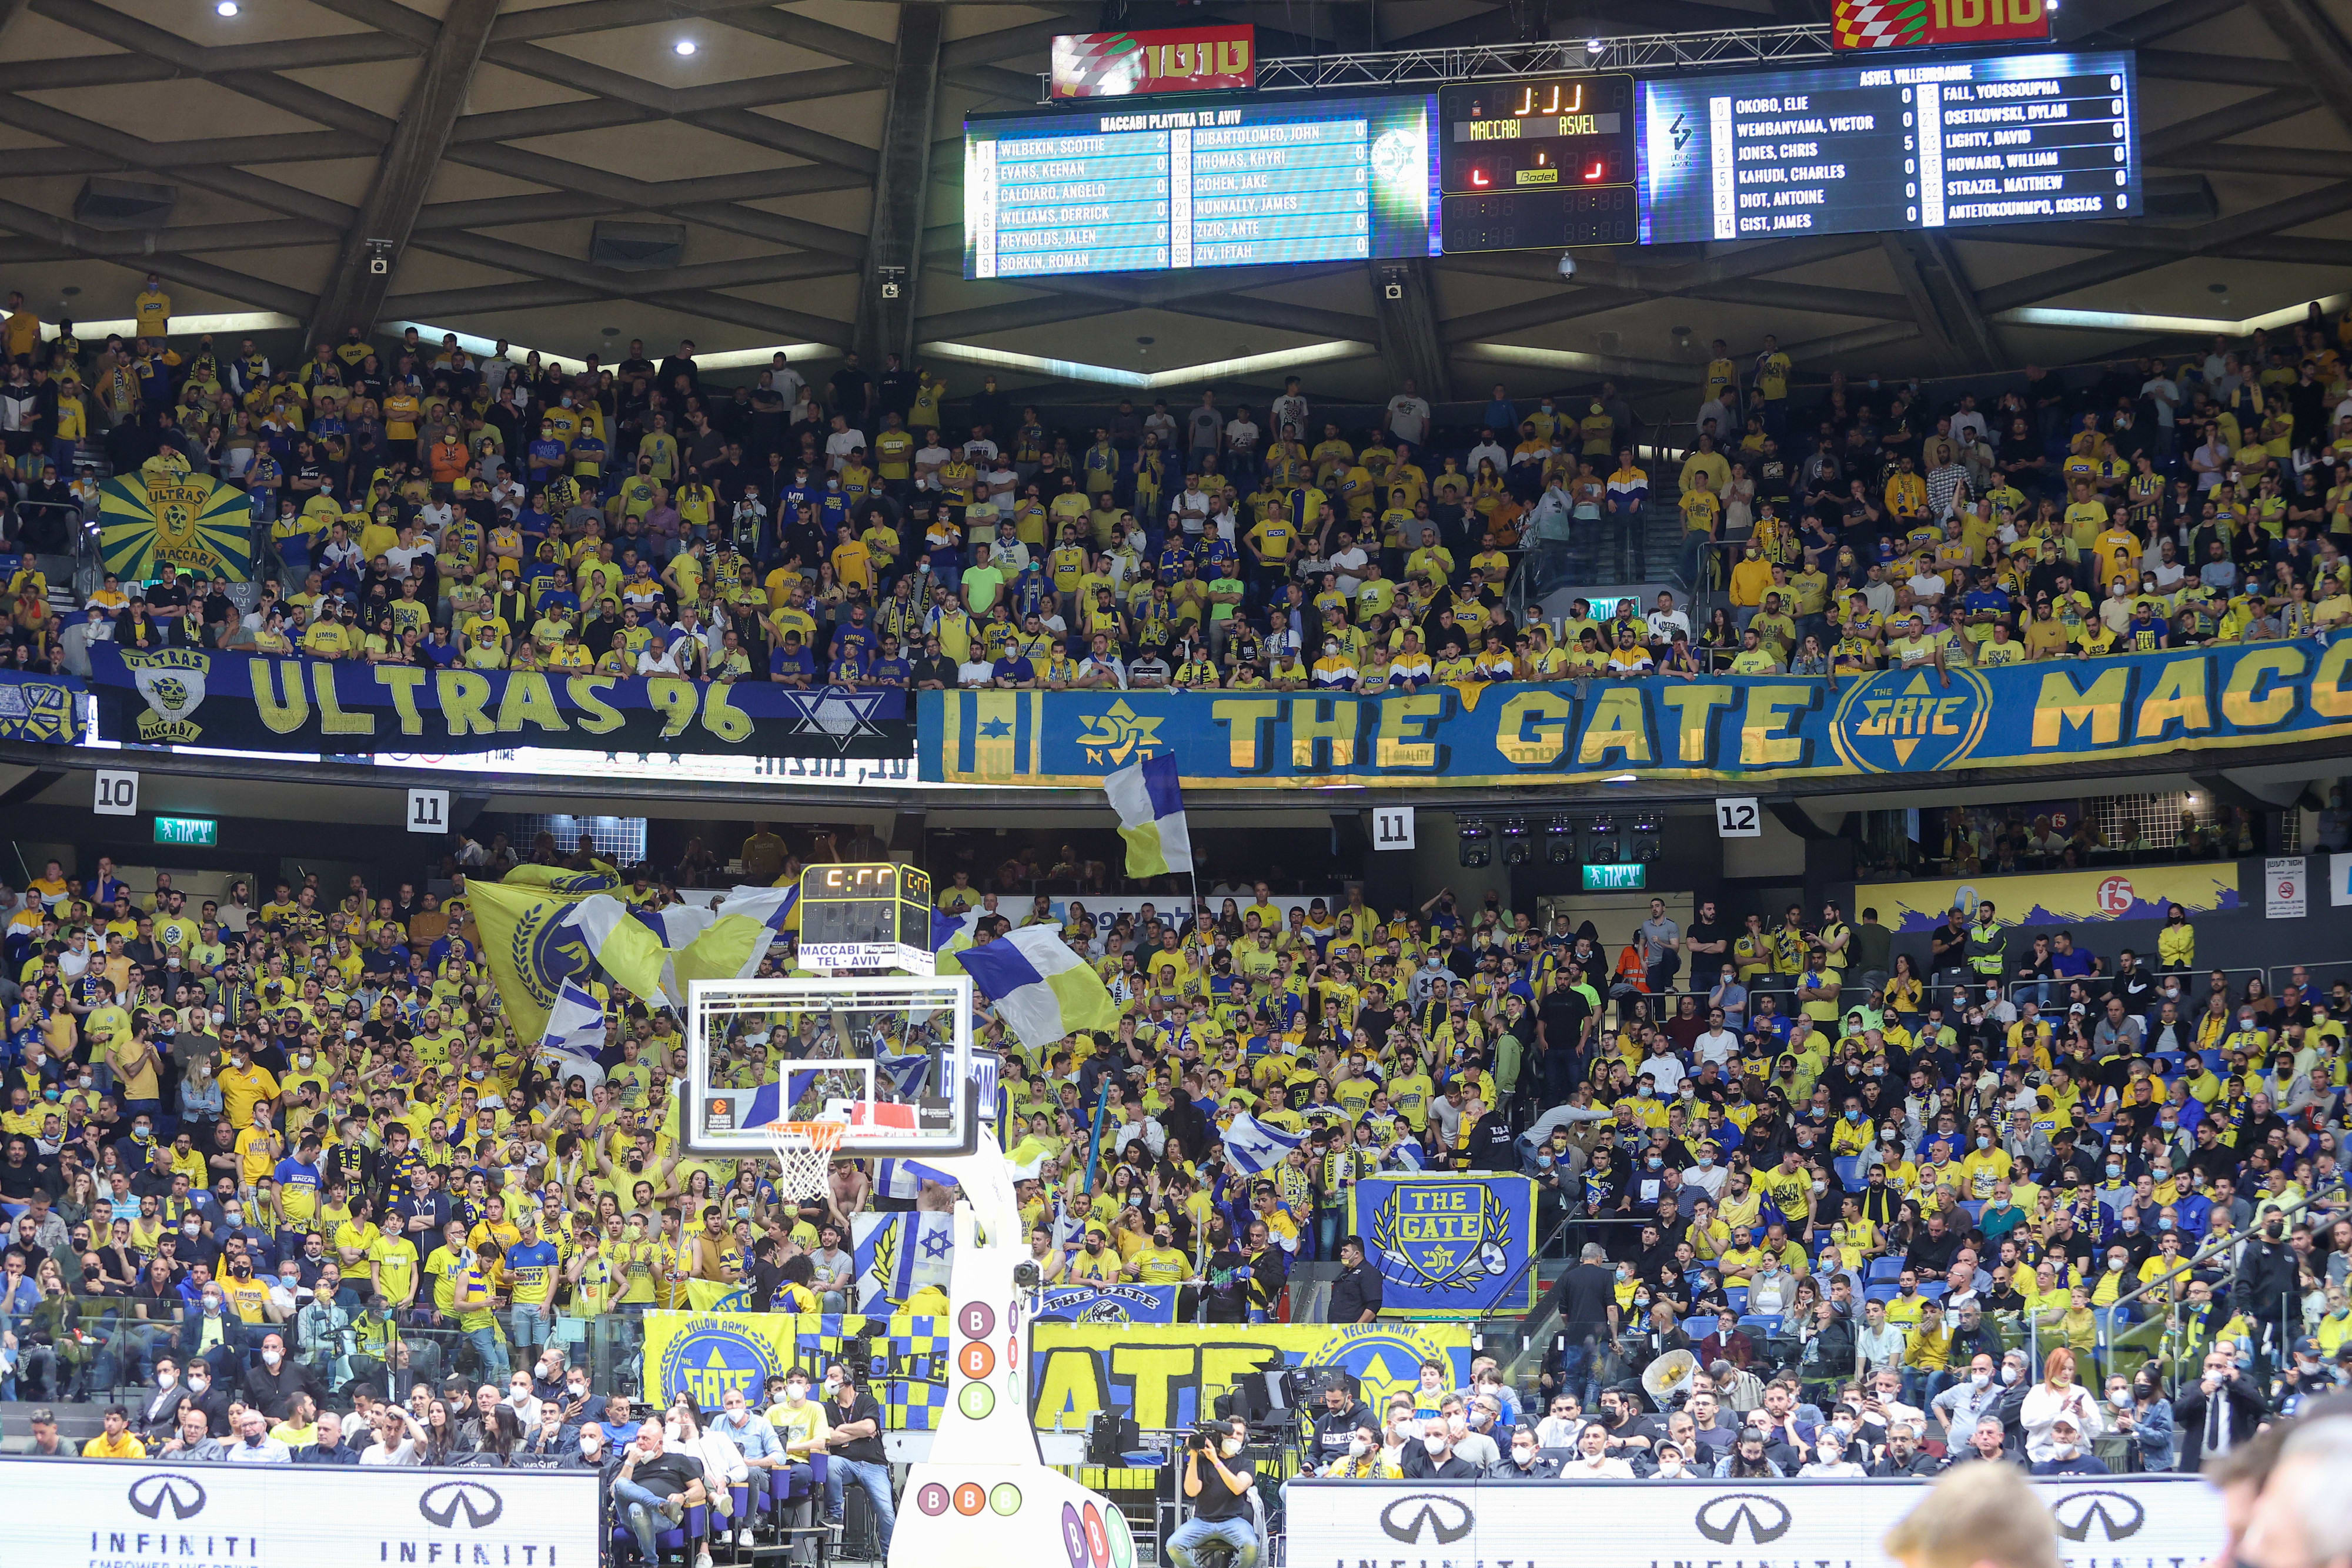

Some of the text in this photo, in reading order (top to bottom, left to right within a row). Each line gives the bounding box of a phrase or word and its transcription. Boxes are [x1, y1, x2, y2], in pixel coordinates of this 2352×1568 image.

[1859, 65, 1973, 87] ASVEL VILLEURBANNE
[1943, 86, 1975, 101] FALL,
[1976, 81, 2060, 99] YOUSSOUPHA
[2110, 75, 2121, 91] 0
[1736, 98, 1782, 114] OKOBO,
[1785, 96, 1809, 111] ELIE
[1902, 88, 1912, 103] 0
[1945, 98, 2122, 125] OSETKOWSKI, DYLAN 0
[1101, 110, 1241, 132] MACCABI PLAYTIKA TEL AVIV
[1470, 115, 1599, 141] MACCABI ASVEL
[1736, 112, 1912, 138] WEMBANYAMA, VICTOR 0
[1176, 126, 1319, 148] 12 DIBARTOLOMEO, JOHN
[1945, 122, 2123, 148] LIGHTY, DAVID 0
[984, 133, 1165, 159] 1 WILBEKIN, SCOTTIE 2
[1738, 135, 1913, 161] JONES, CHRIS 5
[1176, 152, 1285, 170] 13 THOMAS, KHYRI
[1946, 146, 2124, 172] HOWARD, WILLIAM 0
[983, 162, 1084, 182] 2 EVANS, KEENAN
[1519, 172, 1555, 182] Bodet
[1739, 159, 1914, 184] KAHUDI, CHARLES 0
[1176, 175, 1267, 193] 15 COHEN, JAKE
[1947, 170, 2126, 196] STRAZEL, MATTHEW 0
[983, 183, 1105, 205] 4 CALOIARO, ANGELO
[1739, 183, 1915, 208] DIOT, ANTOINE 0
[2056, 196, 2102, 212] KOSTAS
[2116, 193, 2127, 209] 0
[983, 207, 1109, 227] 6 WILLIAMS, DERRICK
[1175, 196, 1297, 217] 21 NUNNALLY, JAMES
[1740, 206, 1916, 232] GIST, JAMES 0
[983, 230, 1096, 249] 8 REYNOLDS, JALEN
[1175, 221, 1259, 239] 23 ZIZIC, ANTE
[983, 254, 1088, 273] 9 SORKIN, ROMAN
[1175, 244, 1252, 263] 99 ZIV, IFTAH
[149, 488, 206, 505] ULTRAS
[155, 549, 212, 569] MACCABI
[844, 634, 864, 643] UM96
[131, 650, 203, 668] ULTRAS
[249, 658, 755, 743] ULTRAS 96
[1873, 688, 1893, 697] THE
[1856, 697, 1968, 735] GATE
[142, 722, 193, 738] MACCABI
[1212, 686, 1811, 768] THE GATE
[99, 778, 134, 806] 10
[414, 797, 442, 825] 11
[1722, 805, 1755, 830] 12
[2052, 813, 2066, 827] f5
[177, 820, 212, 843] יציאה
[1380, 815, 1408, 842] 11
[1604, 866, 1640, 887] יציאה
[2098, 881, 2132, 911] f5
[800, 945, 896, 955] MACCABI Playtika
[817, 956, 880, 965] TEL AVIV
[1411, 1192, 1466, 1211] THE
[1403, 1216, 1478, 1238] GATE
[1151, 1263, 1179, 1272] MACCABI
[1044, 1290, 1094, 1311] THE
[685, 1319, 749, 1335] YELLOW ARMY
[970, 1311, 983, 1331] B
[1011, 1310, 1017, 1326] B
[1342, 1323, 1418, 1339] YELLOW ARMY
[680, 1357, 693, 1367] THE
[970, 1352, 983, 1371] B
[683, 1368, 756, 1410] GATE
[970, 1391, 983, 1411] B
[928, 1490, 1011, 1509] B B B
[91, 1532, 257, 1557] INFINITI
[1068, 1522, 1082, 1559] B
[1089, 1520, 1102, 1556] B
[380, 1542, 556, 1567] INFINITI
